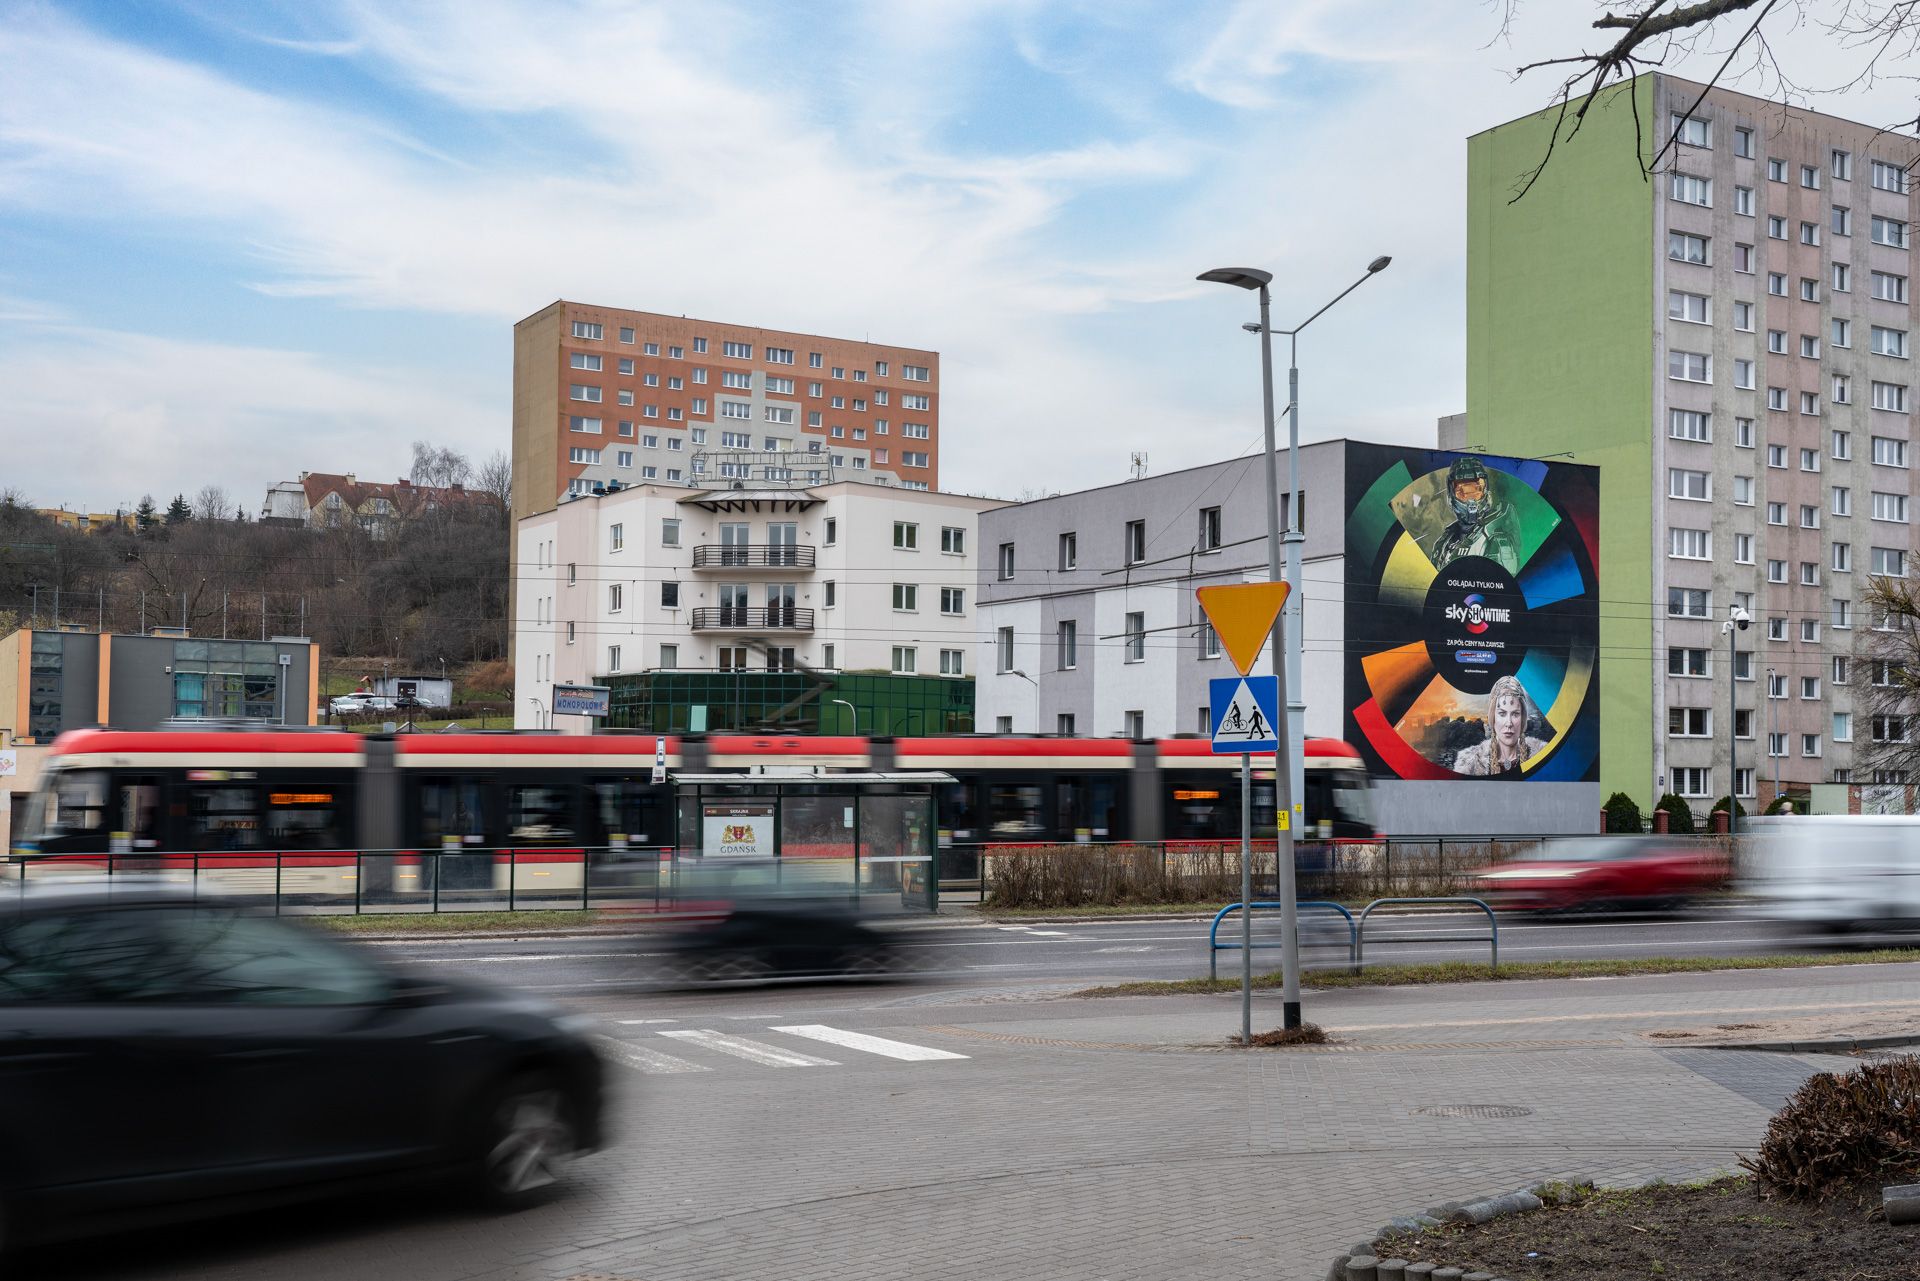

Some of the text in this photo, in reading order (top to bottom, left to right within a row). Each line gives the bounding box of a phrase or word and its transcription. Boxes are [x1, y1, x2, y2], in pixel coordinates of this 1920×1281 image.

[1447, 579, 1504, 590] OGLĄDAJ TYLKO NA
[1485, 641, 1505, 649] ZAWSZE
[720, 844, 756, 853] GDAŃSK
